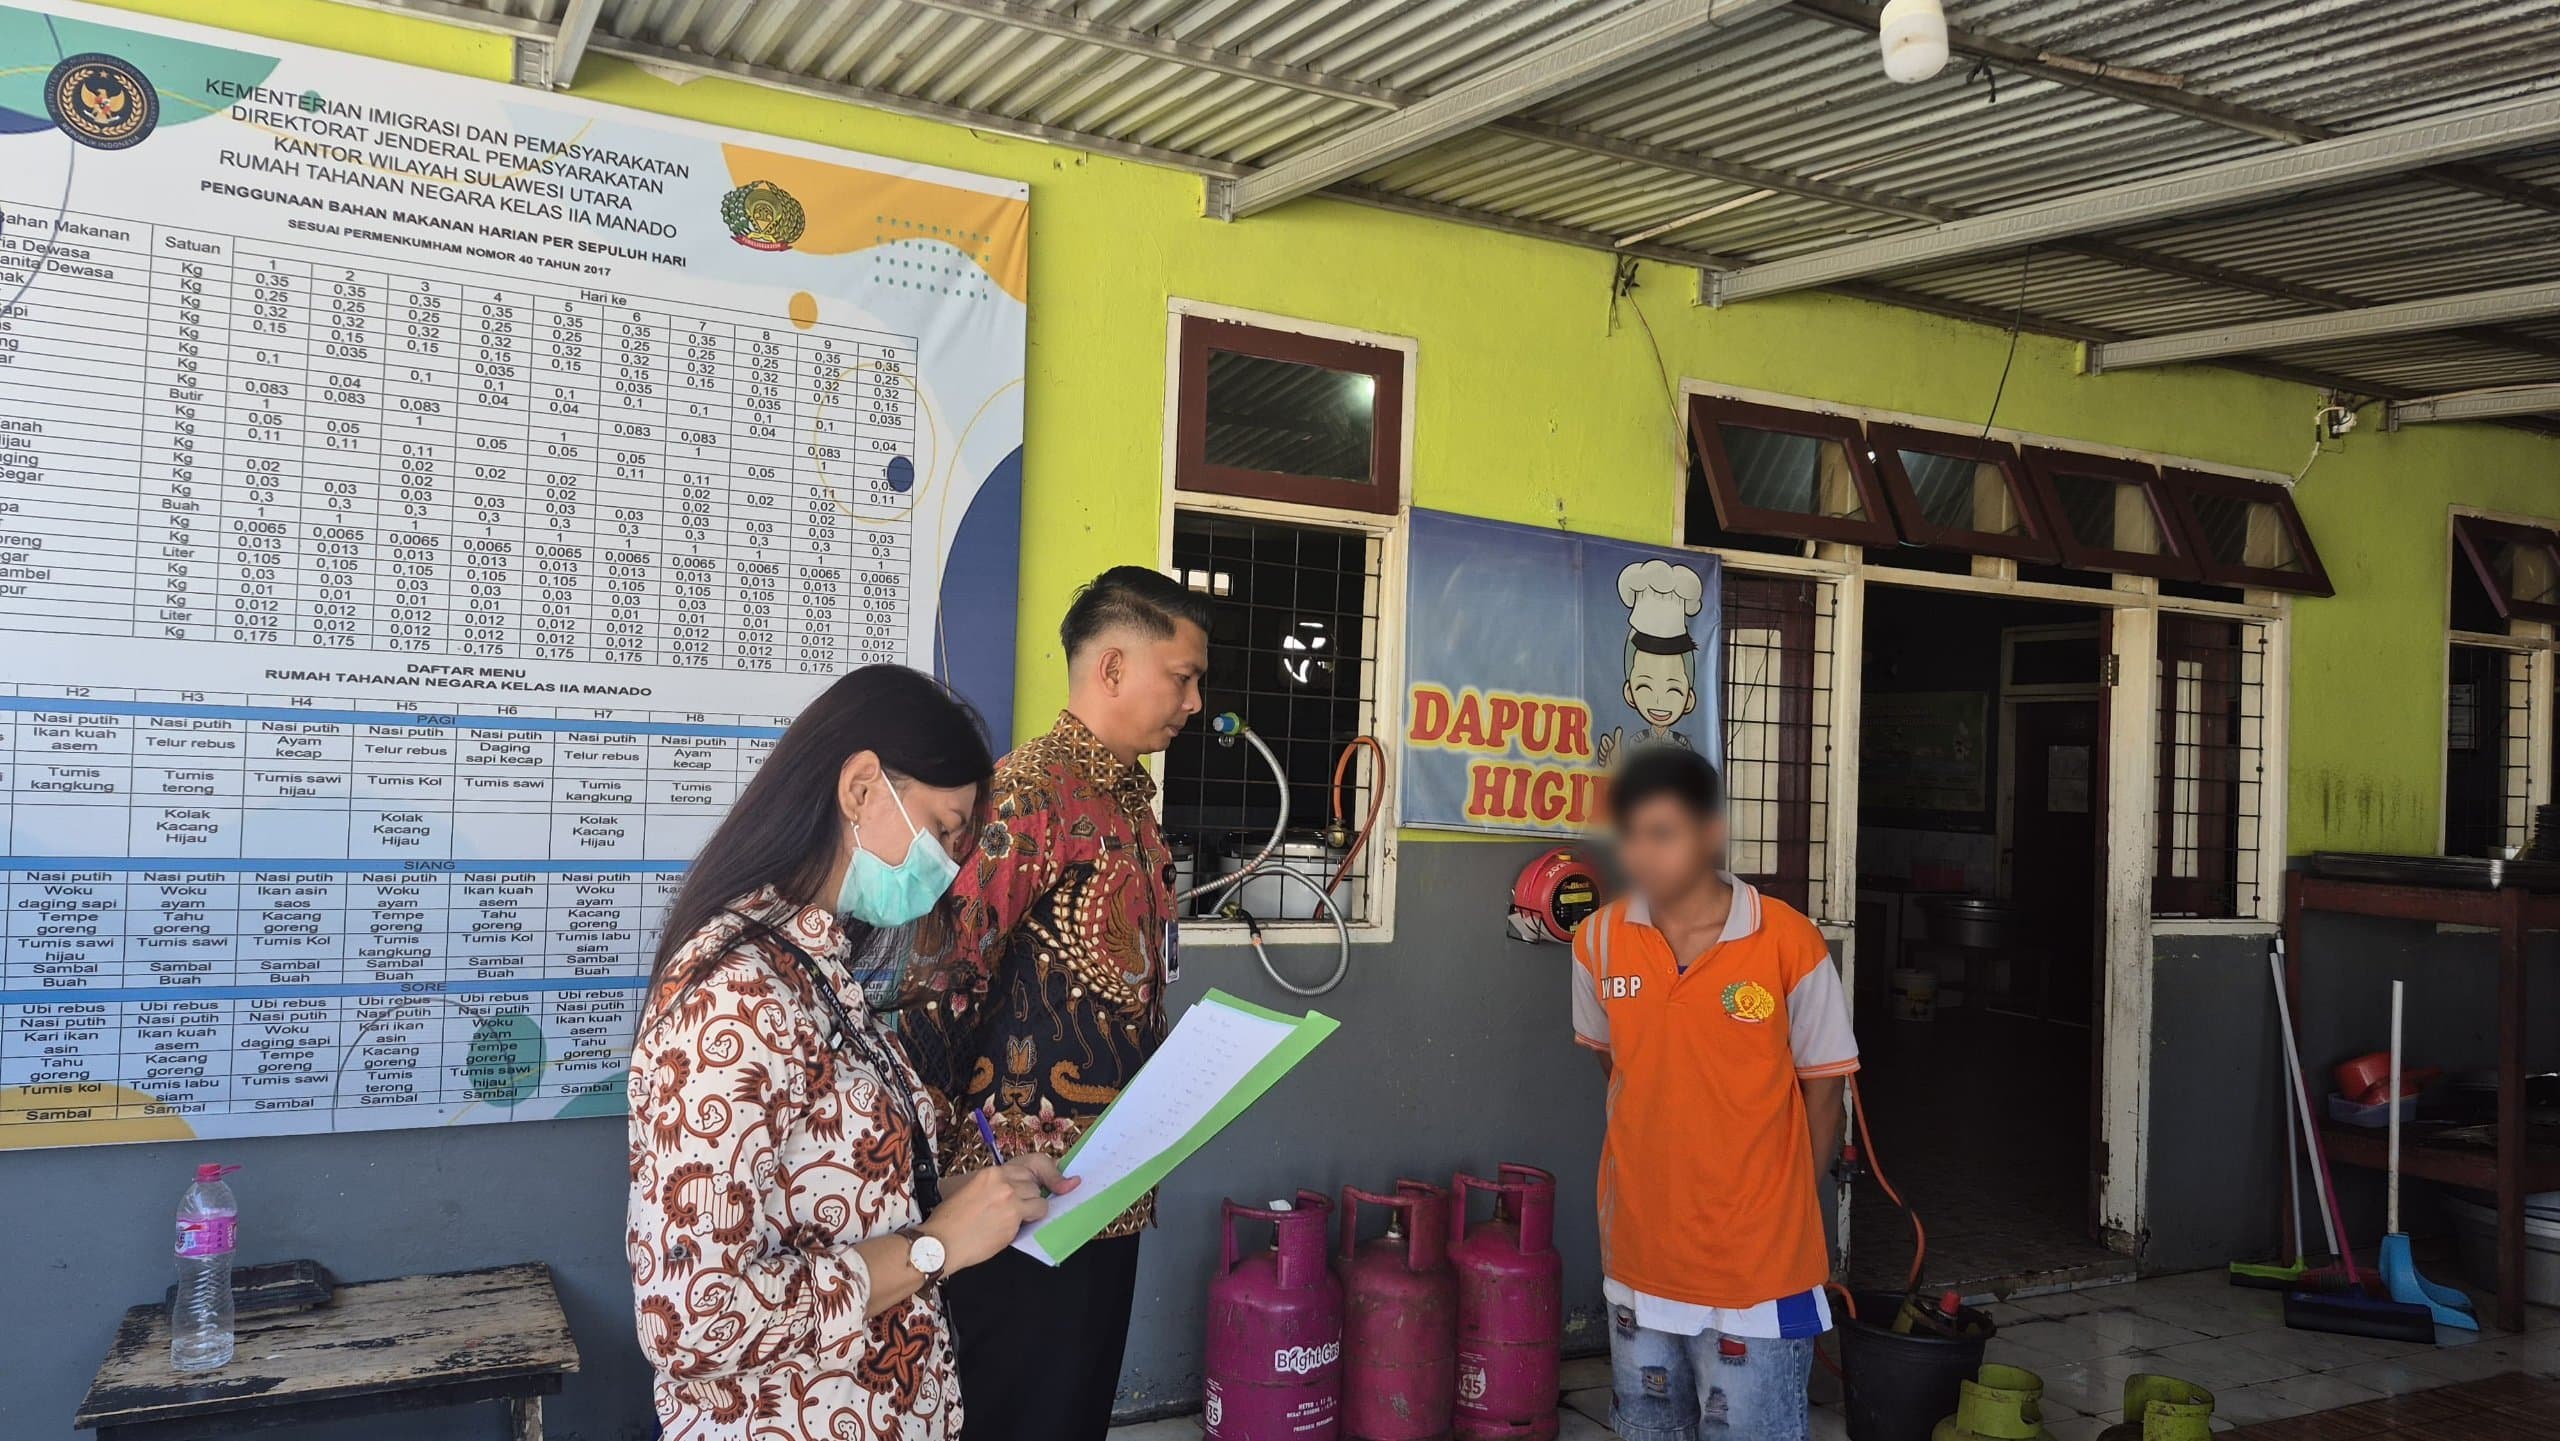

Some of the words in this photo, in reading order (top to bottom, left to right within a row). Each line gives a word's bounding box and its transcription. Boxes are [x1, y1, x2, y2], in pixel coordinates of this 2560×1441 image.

[206, 78, 362, 120] KEMENTERIAN
[369, 108, 460, 138] IMIGRASI
[467, 126, 507, 145] DAN
[514, 134, 689, 179] PEMASYARAKATAN
[232, 106, 369, 142] DIREKTORAT
[374, 131, 480, 162] JENDERAL
[486, 150, 663, 193] PEMASYARAKATAN
[274, 136, 362, 164] KANTOR
[369, 153, 457, 181] WILAYAH
[464, 169, 564, 197] SULAWESI
[571, 187, 632, 210] UTARA
[219, 150, 299, 177] RUMAH
[307, 164, 404, 193] TAHANAN
[411, 183, 495, 208] NEGARA
[500, 199, 563, 219] KELAS
[568, 209, 591, 224] IIA
[596, 212, 677, 239] MANADO
[200, 181, 323, 209] PENGGUNAAN
[329, 201, 388, 219] BAHAN
[393, 211, 473, 232] MAKANAN
[479, 225, 538, 242] HARIAN
[543, 235, 573, 248] PER
[578, 239, 647, 262] SEPULUH
[652, 251, 687, 267] HARI
[54, 220, 130, 241] Makanan
[23, 240, 90, 259] Dewasa
[165, 236, 220, 255] Satuan
[288, 218, 340, 235] SESUAI
[344, 227, 462, 255] PERMENKUMHAM
[466, 245, 515, 262] NOMOR
[519, 254, 533, 264] 40
[537, 257, 580, 273] TAHUN
[584, 264, 611, 277] 2017
[47, 259, 114, 279] Dewasa
[182, 262, 203, 278] Kg
[269, 259, 276, 270] 1
[345, 271, 355, 281] 2
[421, 282, 430, 292] 3
[494, 292, 502, 302] 4
[580, 290, 608, 303] Hari
[612, 295, 627, 305] ke
[565, 303, 572, 312] 5
[554, 315, 583, 328] 0,35
[633, 312, 640, 322] 6
[622, 325, 650, 337] 0,35
[699, 322, 707, 331] 7
[689, 334, 716, 346] 0,35
[762, 331, 770, 341] 8
[753, 343, 779, 355] 0,35
[824, 340, 832, 349] 9
[815, 352, 840, 364] 0,35
[882, 349, 895, 359] 10
[875, 361, 900, 372] 0,35
[169, 388, 203, 401] Butir
[162, 499, 200, 511] Buah
[163, 547, 195, 558] Liter
[605, 551, 650, 564] 0,0065
[673, 557, 715, 569] 0,0065
[737, 562, 779, 574] 0,0065
[800, 567, 840, 580] 0,0065
[861, 573, 900, 585] 0,0065
[160, 609, 192, 621] Liter
[165, 626, 185, 639] Kg
[536, 647, 574, 659] 0,175
[605, 651, 642, 662] 0,175
[737, 659, 771, 671] 0,175
[800, 662, 833, 673] 0,175
[407, 664, 474, 676] DAFTAR
[479, 668, 526, 678] MENU
[265, 670, 330, 682] RUMAH
[336, 673, 420, 686] TAHANAN
[425, 678, 497, 690] NEGARA
[501, 681, 556, 693] KELAS
[560, 684, 580, 694] IIA
[583, 685, 652, 697] MANADO
[66, 687, 89, 697] H2
[181, 692, 204, 702] H3
[291, 698, 312, 707] H4
[397, 702, 417, 711] H5
[497, 706, 517, 715] H6
[594, 710, 613, 718] H7
[34, 713, 72, 724] Nasi
[79, 715, 118, 726] putih
[416, 715, 455, 725] PAGI
[686, 713, 704, 722] H8
[774, 717, 791, 726] H9
[1411, 691, 1589, 755] DAPUR
[150, 718, 187, 728] Nasi
[193, 720, 232, 730] putih
[34, 727, 70, 737] Ikan
[75, 729, 116, 739] kuah
[51, 742, 98, 751] asem
[146, 737, 186, 748] Telur
[192, 740, 235, 749] rebus
[277, 736, 321, 748] Ayam
[276, 749, 322, 759] kecap
[480, 743, 530, 754] Daging
[466, 754, 497, 765] sapi
[499, 755, 542, 765] kecap
[48, 767, 100, 778] Tumis
[164, 771, 214, 781] Tumis
[31, 780, 114, 793] kangkung
[163, 783, 214, 795] terong
[1468, 766, 1613, 823] HIGI
[580, 815, 617, 825] Kolak
[572, 827, 624, 837] Kacang
[580, 838, 615, 847] Hijau
[404, 861, 456, 870] SIANG
[27, 872, 65, 881] Nasi
[72, 872, 112, 883] putih
[45, 886, 93, 895] Woku
[19, 900, 76, 911] daging
[82, 899, 116, 911] sapi
[39, 912, 98, 922] Tempe
[568, 910, 620, 920] Kacang
[37, 925, 96, 935] goreng
[570, 921, 617, 930] goreng
[18, 939, 71, 948] Tumis
[76, 938, 114, 947] sawi
[45, 952, 84, 962] hijau
[33, 964, 98, 974] Sambal
[43, 978, 87, 987] Buah
[401, 983, 447, 992] SORE
[23, 1005, 50, 1014] Ubi
[58, 1004, 105, 1013] rebus
[20, 1018, 59, 1027] Nasi
[66, 1017, 105, 1028] putih
[24, 1032, 58, 1041] Kari
[64, 1031, 98, 1040] ikan
[570, 1027, 607, 1036] asem
[572, 1038, 606, 1046] Tahu
[44, 1044, 78, 1054] asin
[564, 1049, 611, 1059] goreng
[41, 1058, 83, 1067] Tahu
[555, 1062, 596, 1071] Tumis
[602, 1060, 620, 1068] kol
[30, 1070, 89, 1082] goreng
[19, 1085, 72, 1095] Tumis
[79, 1083, 101, 1092] kol
[561, 1084, 613, 1094] Sambal
[26, 1109, 91, 1120] Sambal
[1278, 1350, 1321, 1371] Bright
[1324, 1343, 1339, 1360] Gas
